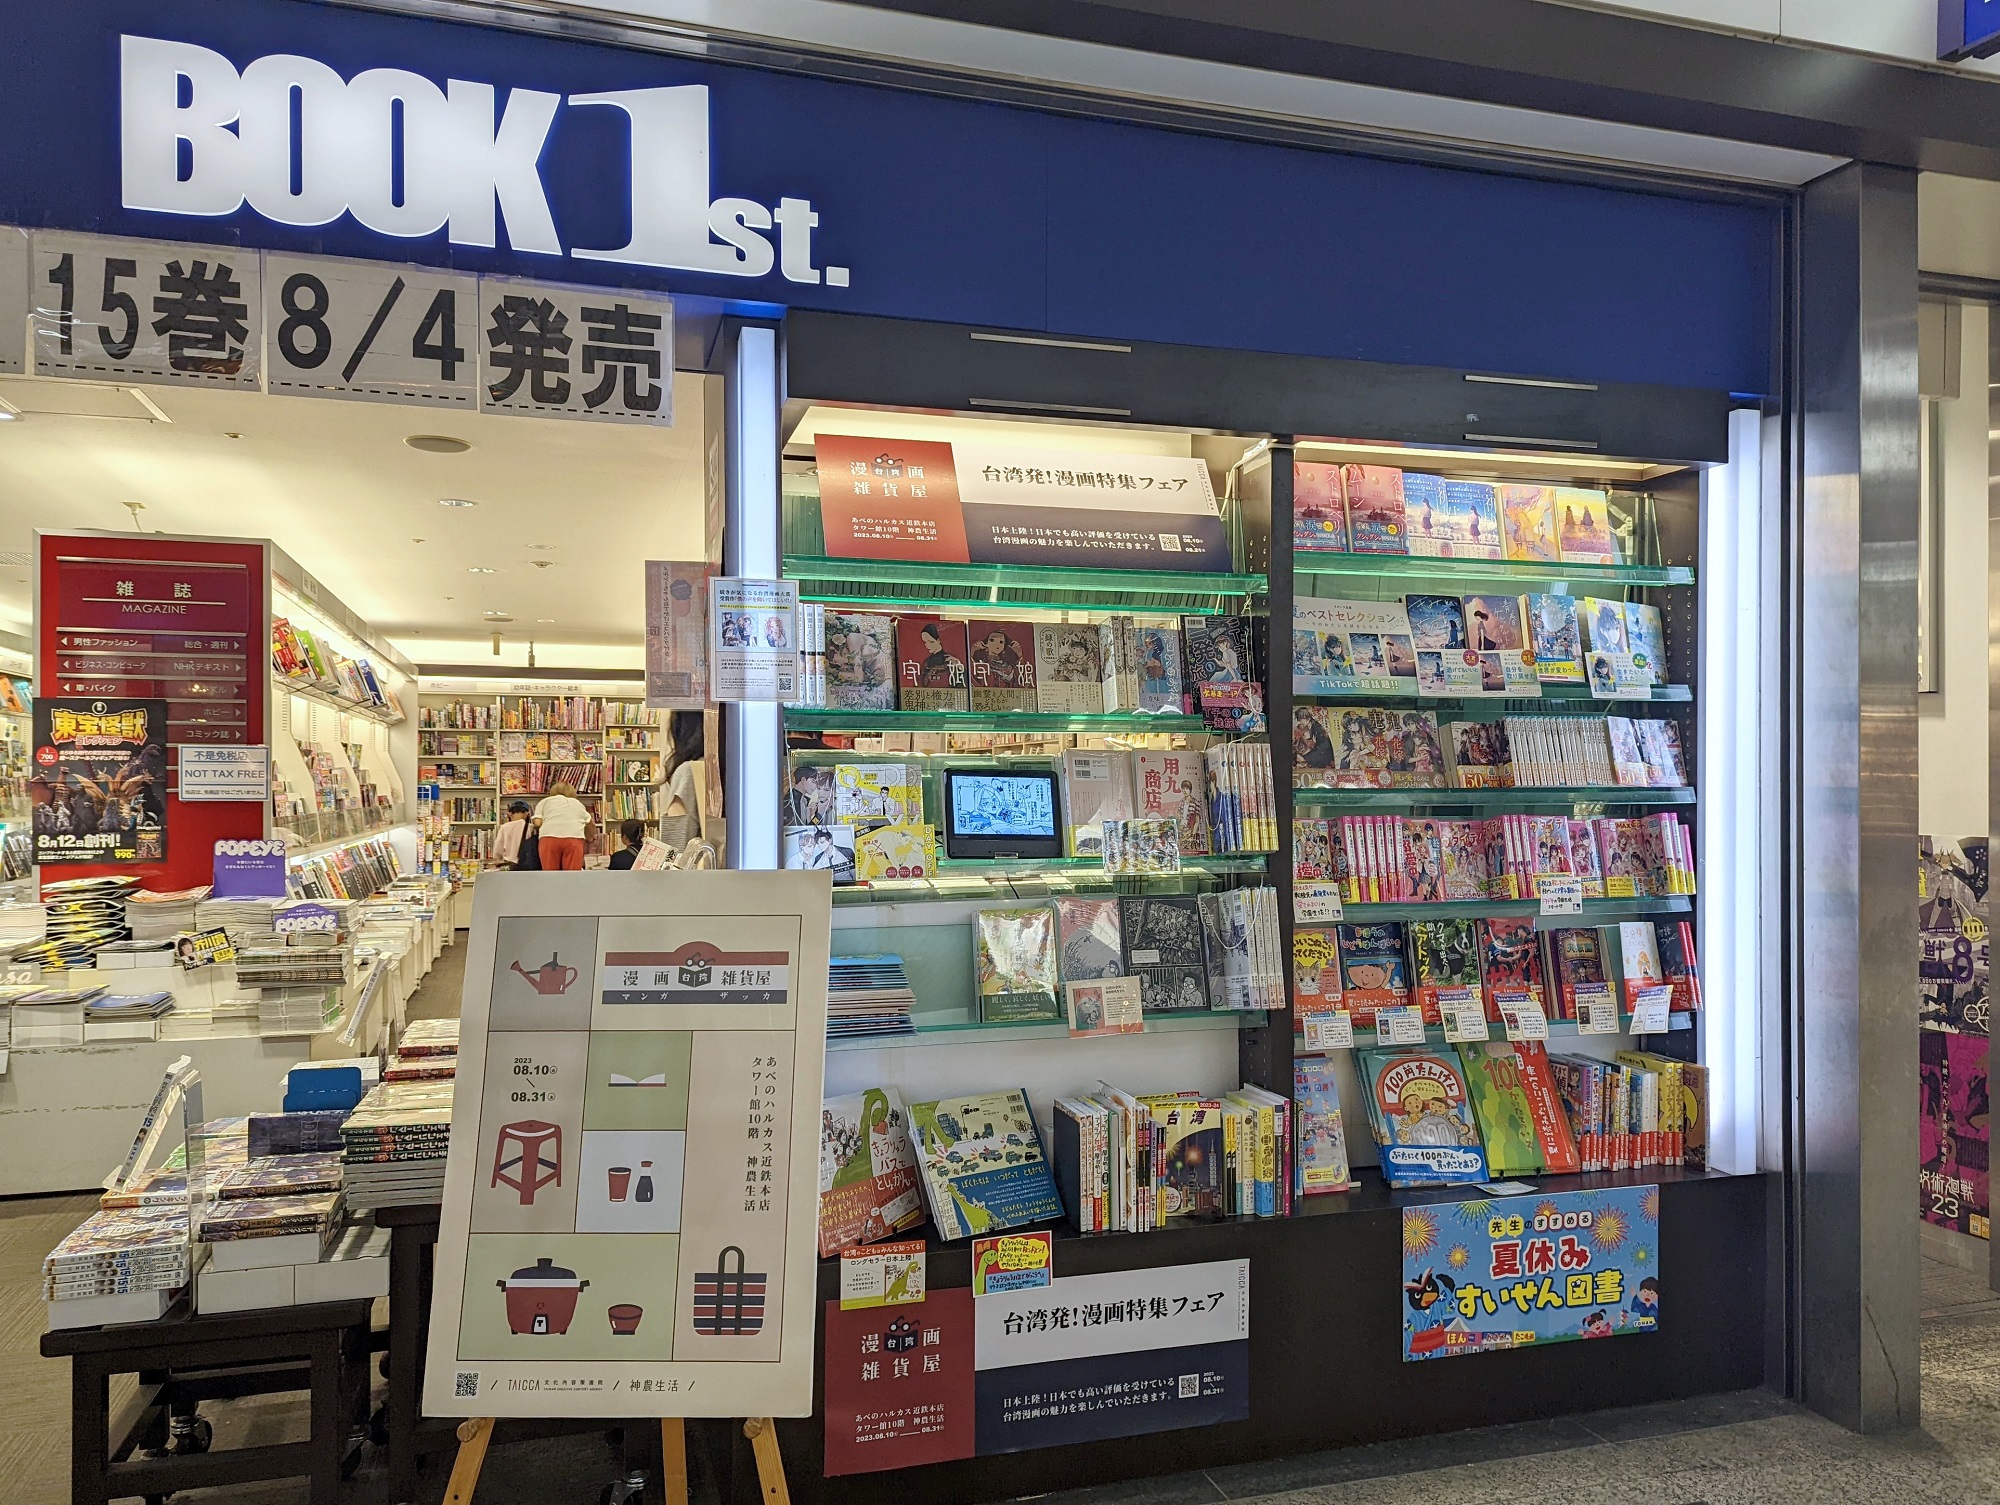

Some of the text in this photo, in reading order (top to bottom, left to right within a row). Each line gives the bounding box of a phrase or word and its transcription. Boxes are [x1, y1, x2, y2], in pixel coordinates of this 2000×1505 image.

[121, 34, 561, 256] BOOK
[49, 252, 661, 411] 15巻 8/4 発売
[982, 465, 1188, 493] 台湾発!漫画特集フェア
[1351, 471, 1365, 508] ムーン
[1327, 470, 1344, 547] ストロベリー
[1390, 473, 1410, 549] ストロベリー
[122, 604, 187, 615] MAGAZINE
[73, 637, 138, 647] 男性ファッション
[75, 659, 146, 670] ビジネス・コンピュータ
[174, 662, 230, 672] NHKテキスト
[75, 683, 116, 693] 車・バイク
[204, 707, 230, 716] ホビー
[54, 710, 146, 739] 東宝怪獣
[186, 731, 229, 739] コミック誌
[184, 769, 265, 779] NOT TAX FREE
[1161, 757, 1182, 794] 用九
[1144, 768, 1162, 810] 商店
[37, 833, 121, 848] 8月12日創刊!
[215, 840, 285, 857] POPEYE
[275, 913, 337, 934] POPEYE
[682, 972, 708, 983] 台湾
[720, 970, 772, 987] 雑貨屋
[622, 991, 771, 1001] マンガ ザッカ
[141, 1117, 152, 1128] 15
[1166, 1110, 1207, 1126] 台湾
[744, 1056, 763, 1212] タワー館10階 神農生活
[758, 1056, 777, 1211] あべのハルカス近鉄本店
[961, 1176, 990, 1188] ぼくたちは
[1931, 1193, 1960, 1219] 23
[1491, 1211, 1593, 1235] 先生のすすめる
[850, 1254, 916, 1266] ロングセラー日本上陸!
[1490, 1236, 1592, 1278] 夏休み
[1237, 1265, 1246, 1290] TAICCA
[1455, 1270, 1624, 1318] すいせん図書
[1003, 1291, 1225, 1335] 台湾発!漫画特集フェア
[1447, 1333, 1466, 1344] ほん
[860, 1353, 942, 1382] 雑貨屋
[508, 1379, 540, 1391] TAICCA
[630, 1379, 679, 1392] 神農生活
[855, 1403, 945, 1423] あべのハルカス近鉄本店
[855, 1414, 945, 1434] タワー館10階 神農生活
